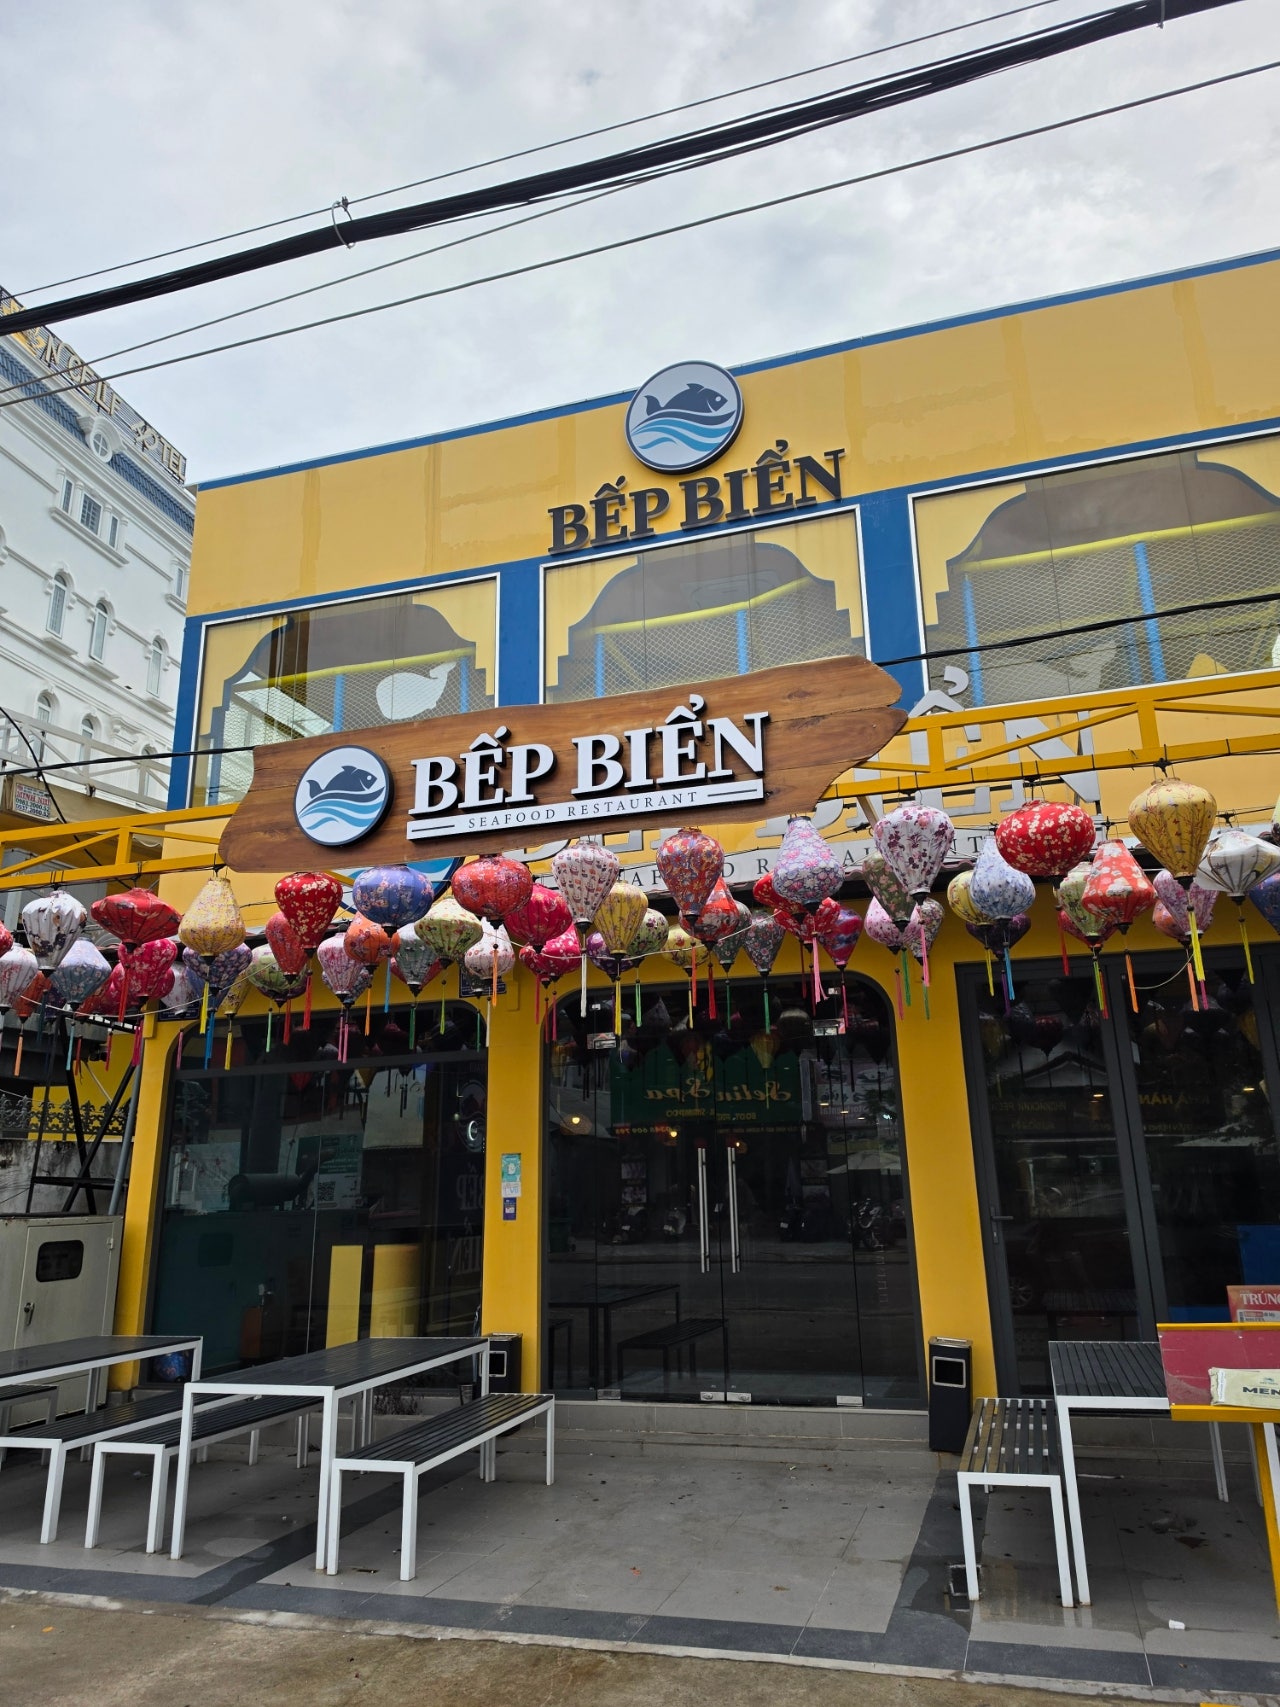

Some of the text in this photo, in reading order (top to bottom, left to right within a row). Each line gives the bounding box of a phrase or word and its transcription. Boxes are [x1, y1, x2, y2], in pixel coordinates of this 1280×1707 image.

[547, 439, 846, 554] BẾP BIỂN
[408, 694, 769, 815] BẾP BIỂN
[468, 791, 698, 829] SEAFOOD RESTAURANT
